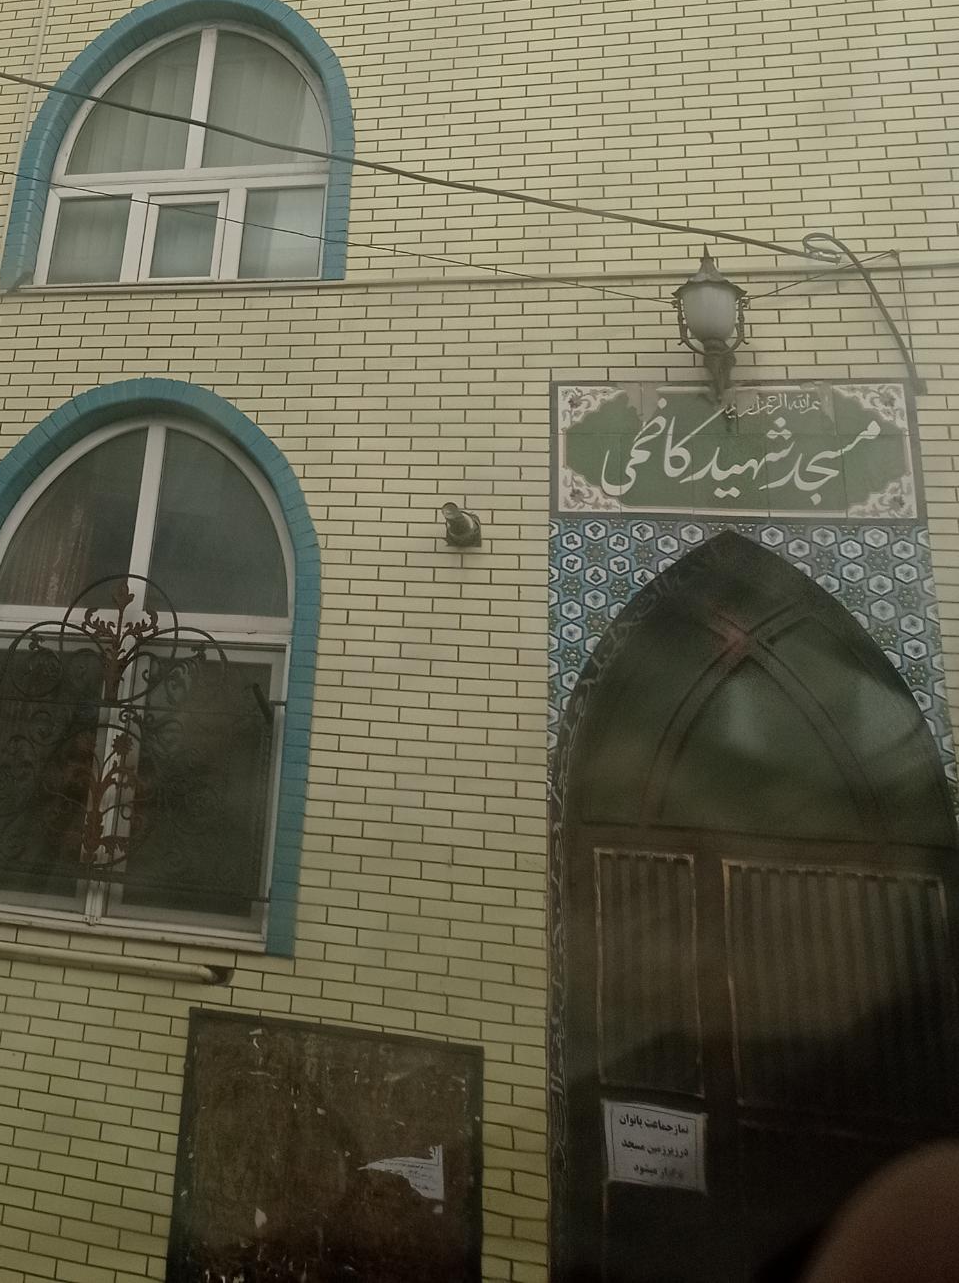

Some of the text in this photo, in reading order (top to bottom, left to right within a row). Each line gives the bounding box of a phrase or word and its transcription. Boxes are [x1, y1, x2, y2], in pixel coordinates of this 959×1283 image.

[601, 396, 881, 505] مسجد شهید کاظمی
